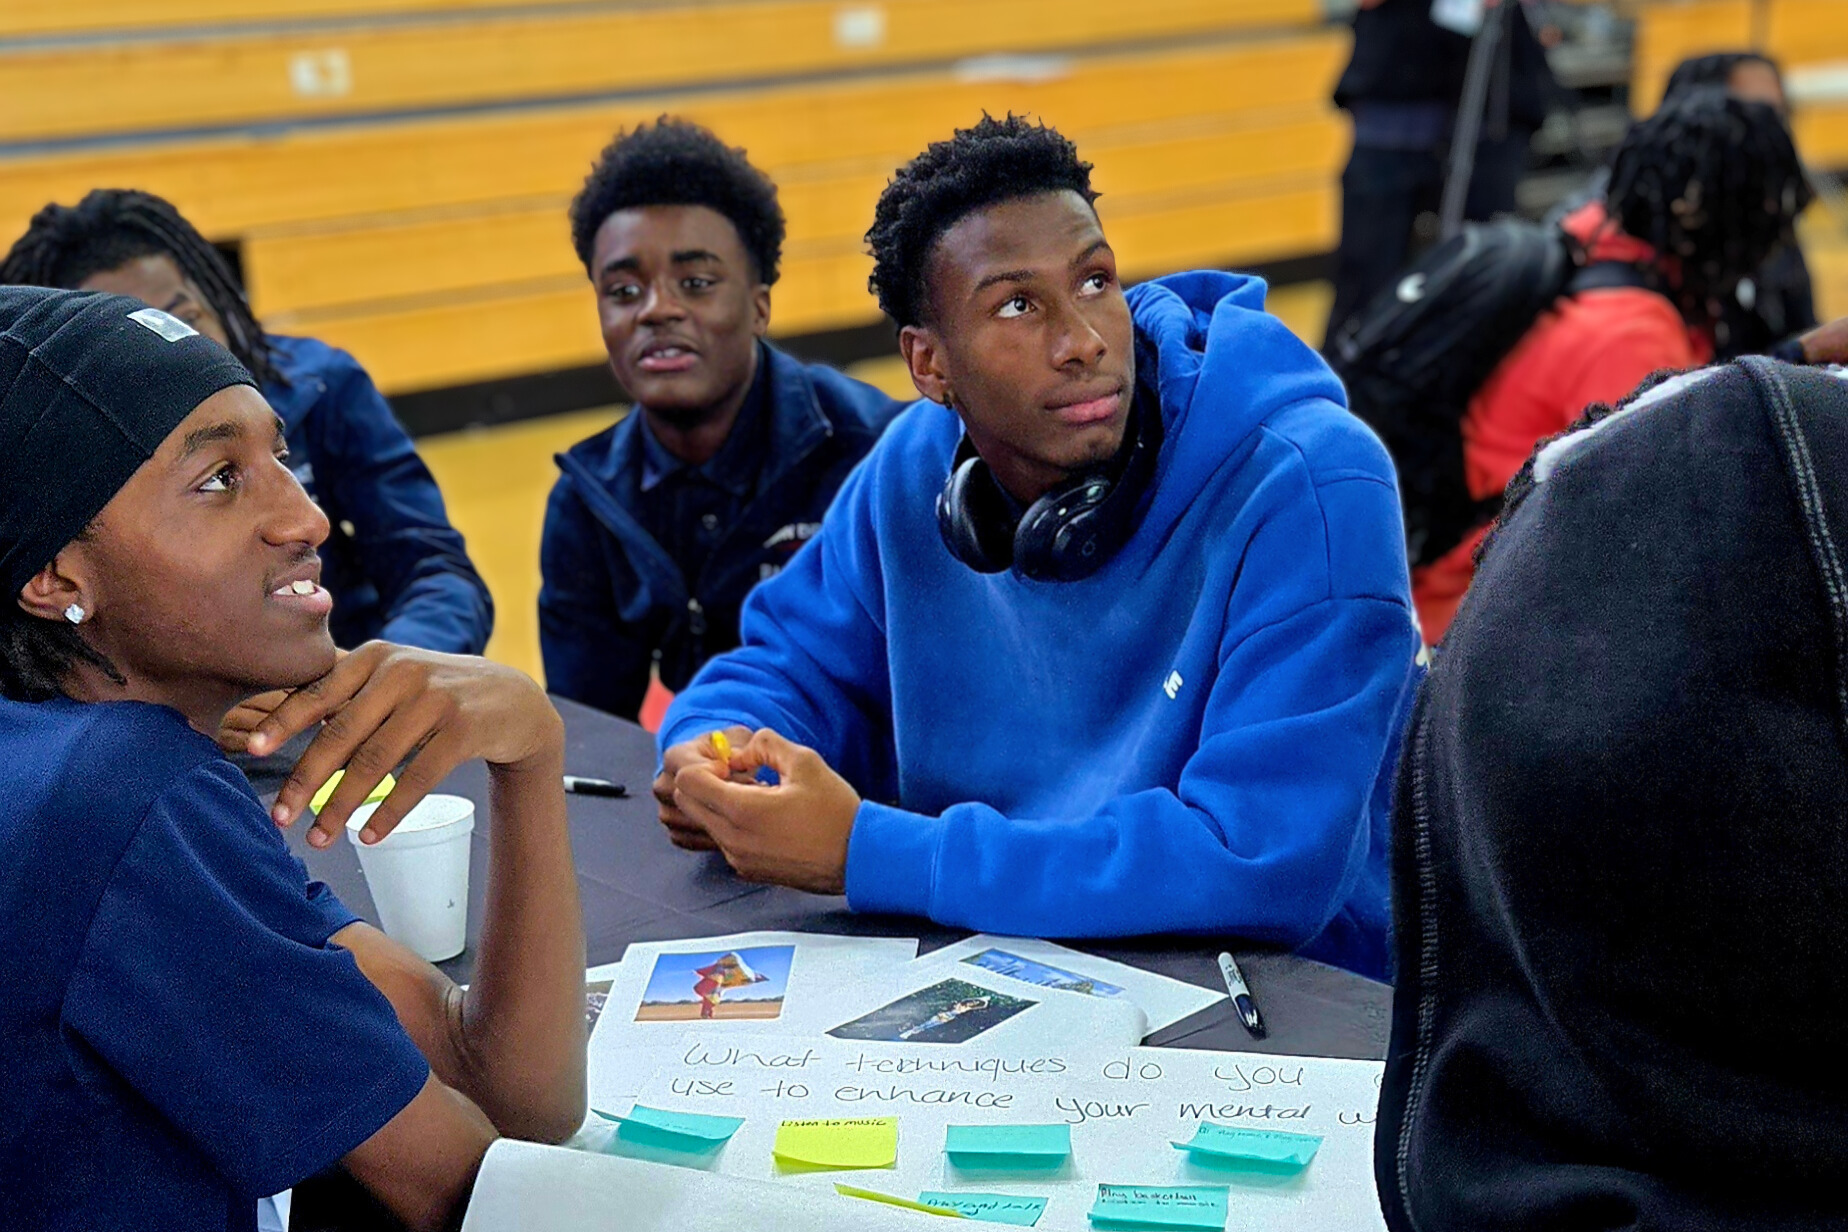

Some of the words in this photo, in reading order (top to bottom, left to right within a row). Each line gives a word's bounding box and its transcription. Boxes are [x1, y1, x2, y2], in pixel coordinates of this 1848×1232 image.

[683, 1042, 821, 1068] What
[1103, 1056, 1162, 1081] do
[1214, 1063, 1304, 1091] you
[671, 1077, 734, 1097] use
[761, 1080, 809, 1098] to
[834, 1085, 1014, 1109] enhance
[1055, 1096, 1150, 1124] your
[1179, 1101, 1311, 1120] mental
[843, 1118, 887, 1127] music
